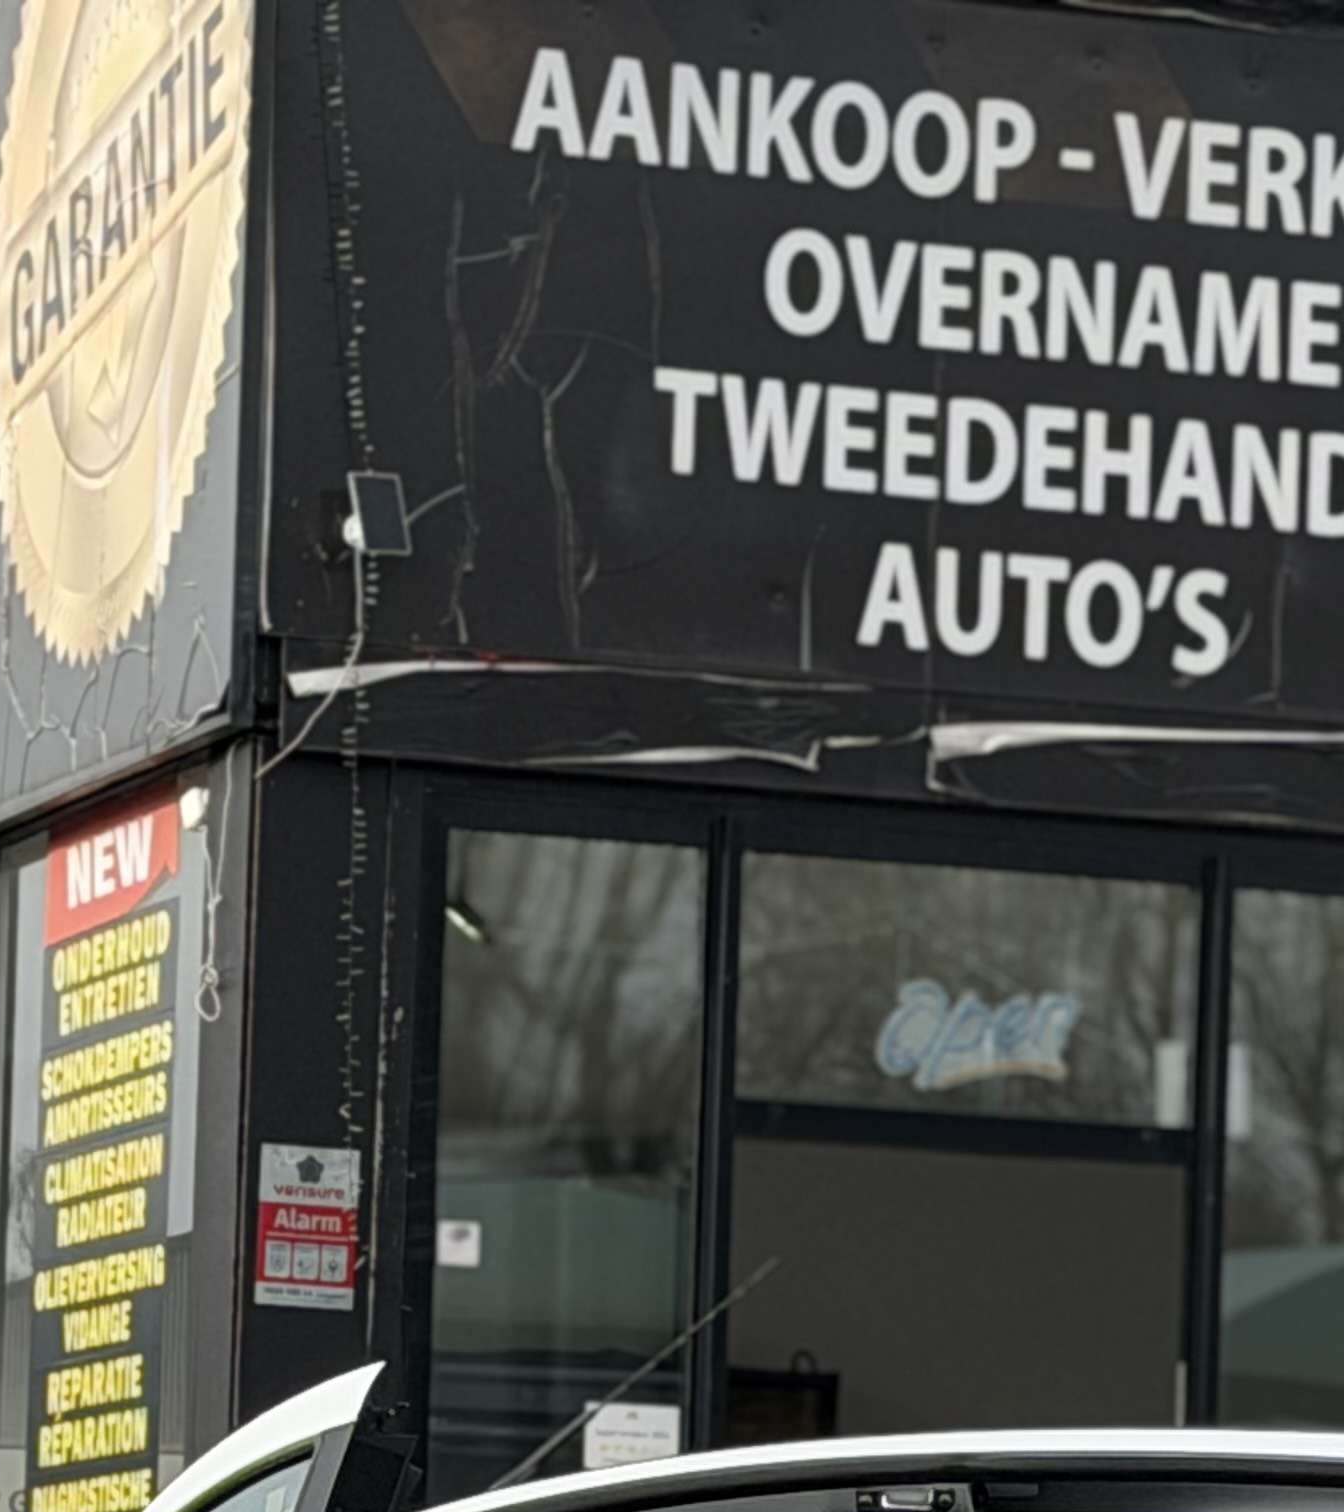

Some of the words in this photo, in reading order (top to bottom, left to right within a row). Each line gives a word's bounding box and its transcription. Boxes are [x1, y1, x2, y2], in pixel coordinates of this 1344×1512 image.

[511, 48, 1036, 202] AANKOOP
[1059, 148, 1094, 171] -
[11, 3, 226, 385] GARANTIE
[765, 228, 1342, 388] OVERNAME
[857, 542, 1229, 676] AUTO'S
[66, 814, 155, 911] NEW
[52, 909, 172, 992] ONDERHOUD
[59, 960, 161, 1037] ENTRETIEN
[41, 1020, 174, 1102] SCHOKDEMPERS
[43, 1070, 168, 1148] AMORTISSEURS
[43, 1132, 164, 1205] CLIMATISATION
[273, 1182, 346, 1201] verisure
[56, 1187, 147, 1249] RADIATEUR
[274, 1206, 343, 1234] Alarm
[33, 1244, 166, 1313] OLIEVERVERSING
[62, 1299, 133, 1354] VIDANGE
[46, 1353, 144, 1416] REPARATIE
